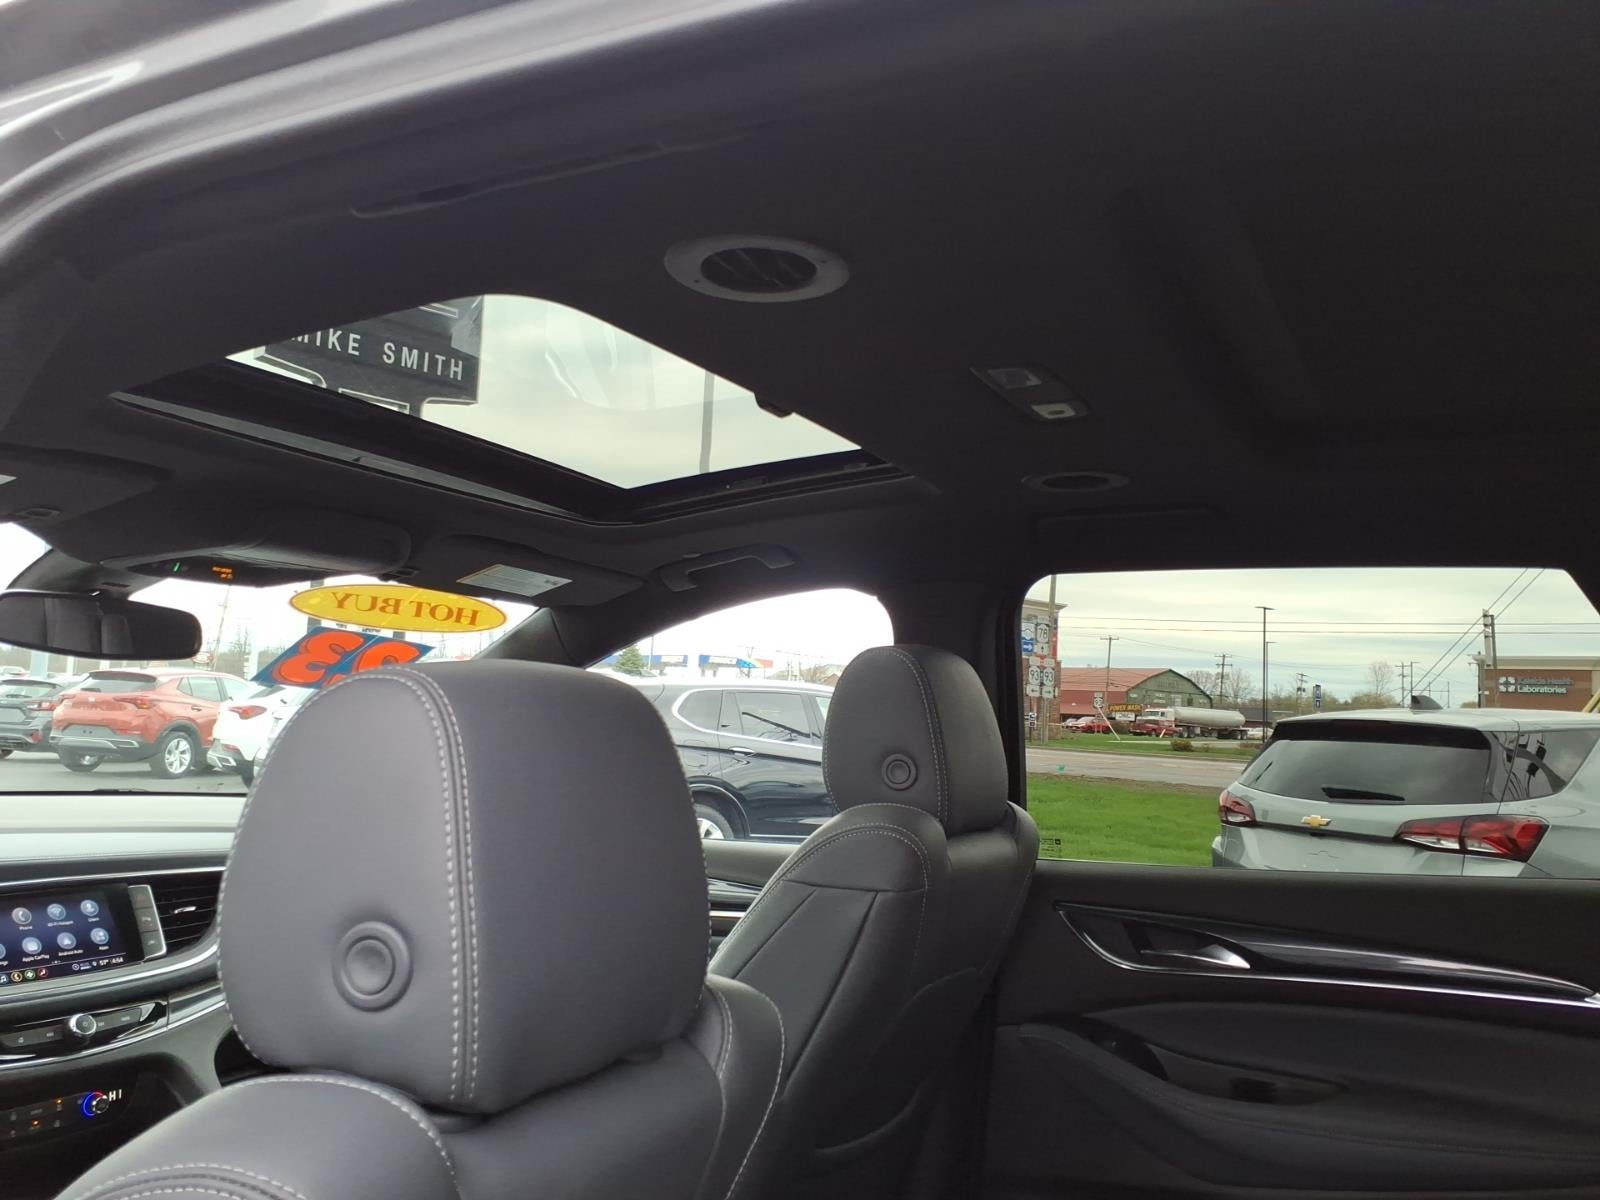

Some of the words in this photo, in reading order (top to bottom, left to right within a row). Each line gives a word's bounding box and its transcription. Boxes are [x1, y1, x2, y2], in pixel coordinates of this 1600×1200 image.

[383, 342, 463, 381] SMITH
[1029, 669, 1039, 681] 93
[1044, 671, 1054, 682] 93
[1518, 685, 1567, 694] Laboratories
[108, 1088, 122, 1102] HI
